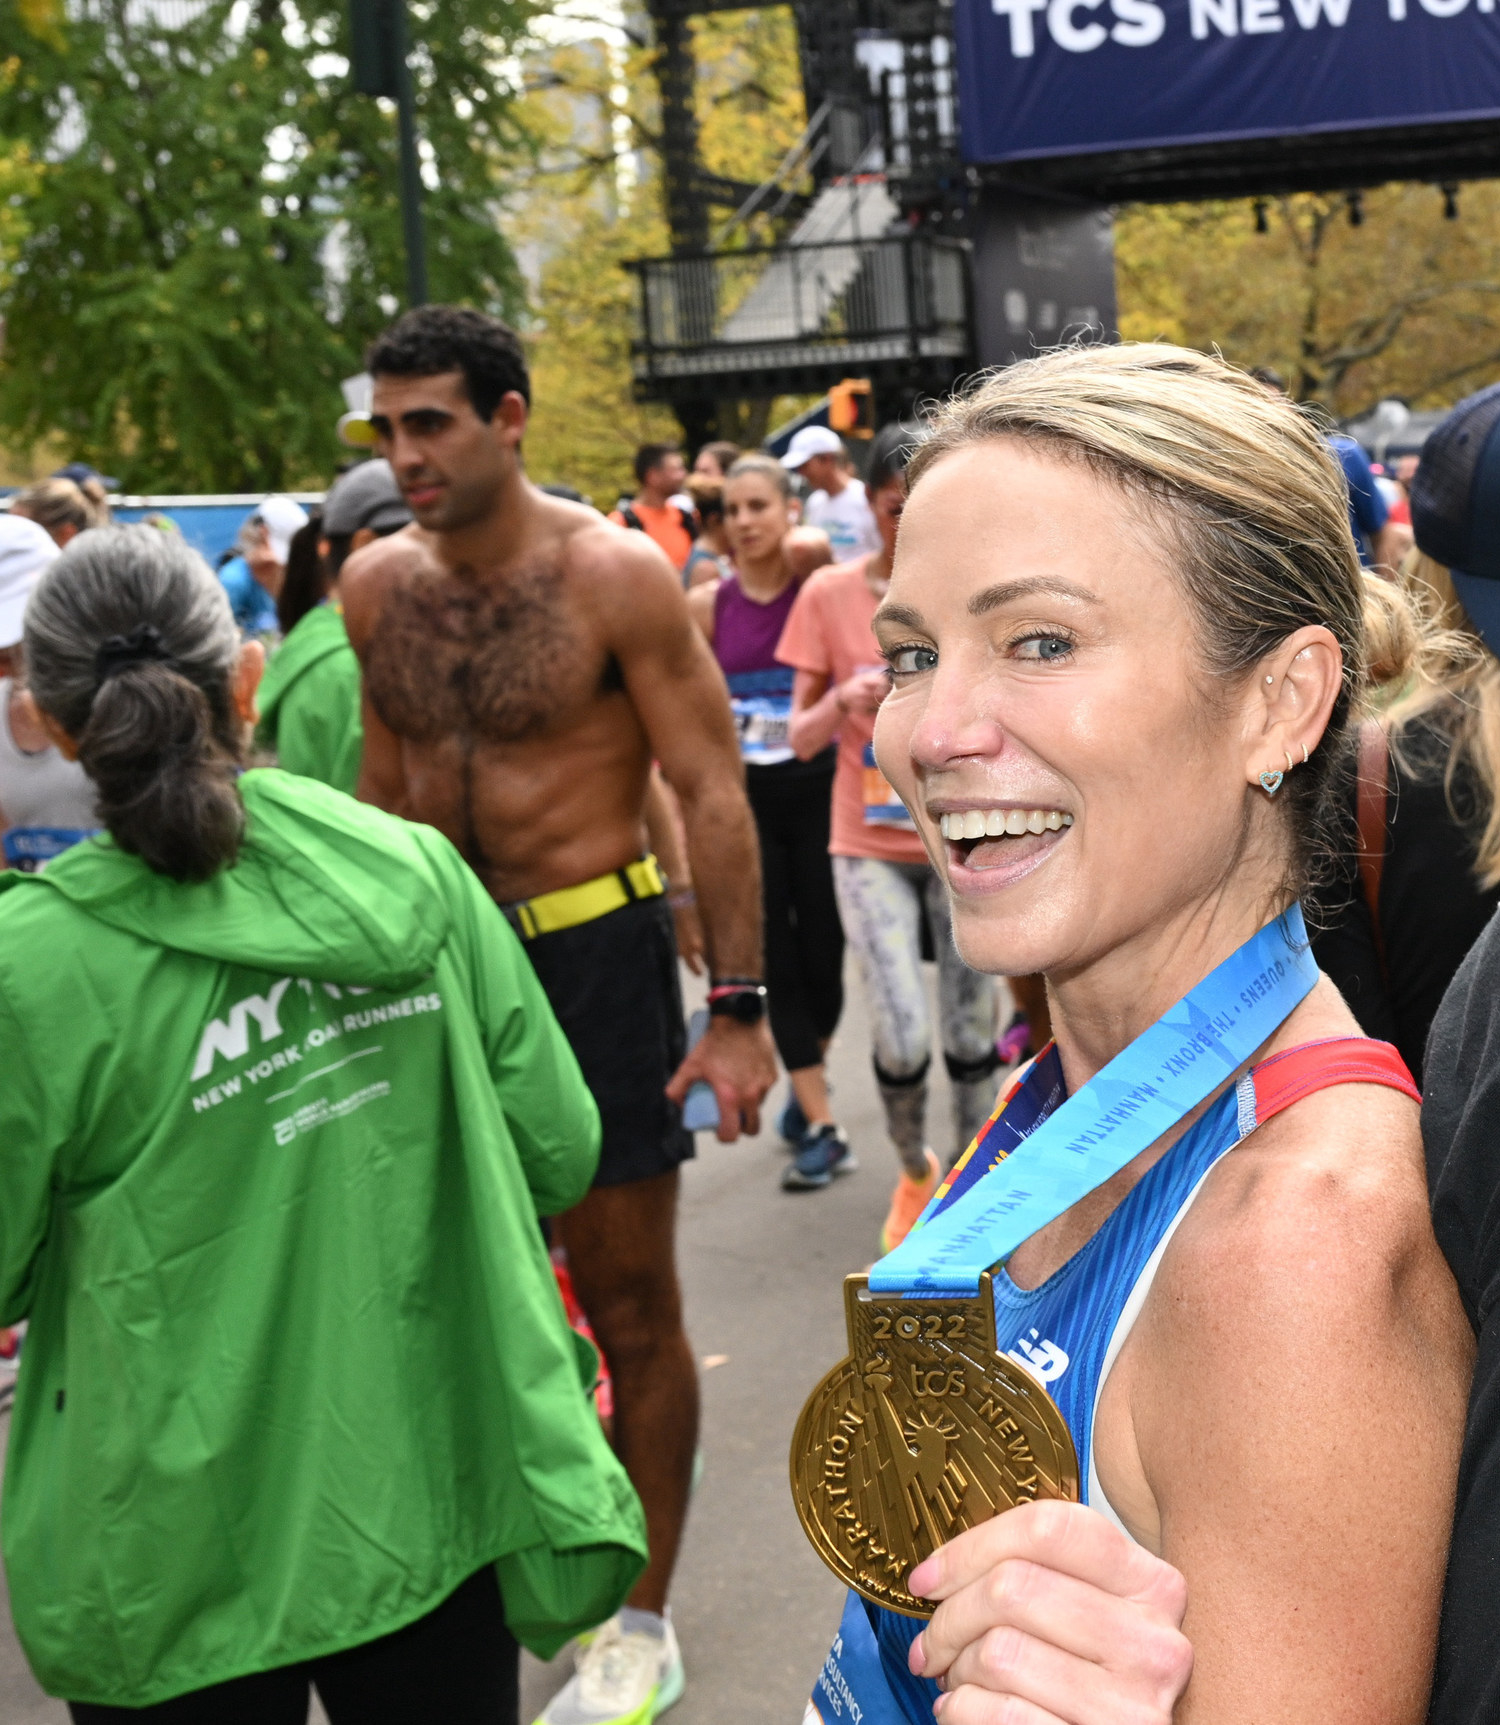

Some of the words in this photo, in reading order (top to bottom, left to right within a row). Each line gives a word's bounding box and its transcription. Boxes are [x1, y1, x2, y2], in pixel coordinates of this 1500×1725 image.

[991, 0, 1167, 58] TCS
[1240, 960, 1285, 1009] QUEENS
[193, 1075, 242, 1113] NEW
[244, 1044, 303, 1084] YORK
[343, 992, 442, 1032] RUNNERS
[1205, 1010, 1236, 1039] THE
[1161, 1031, 1213, 1077] BRONX
[1065, 1082, 1160, 1155] MANHATTAN
[913, 1189, 1033, 1290] MANHATTAN
[872, 1315, 968, 1340] 2022
[977, 1399, 1035, 1465] NEW
[825, 1407, 909, 1580] MARATHON
[858, 1570, 888, 1594] NEW
